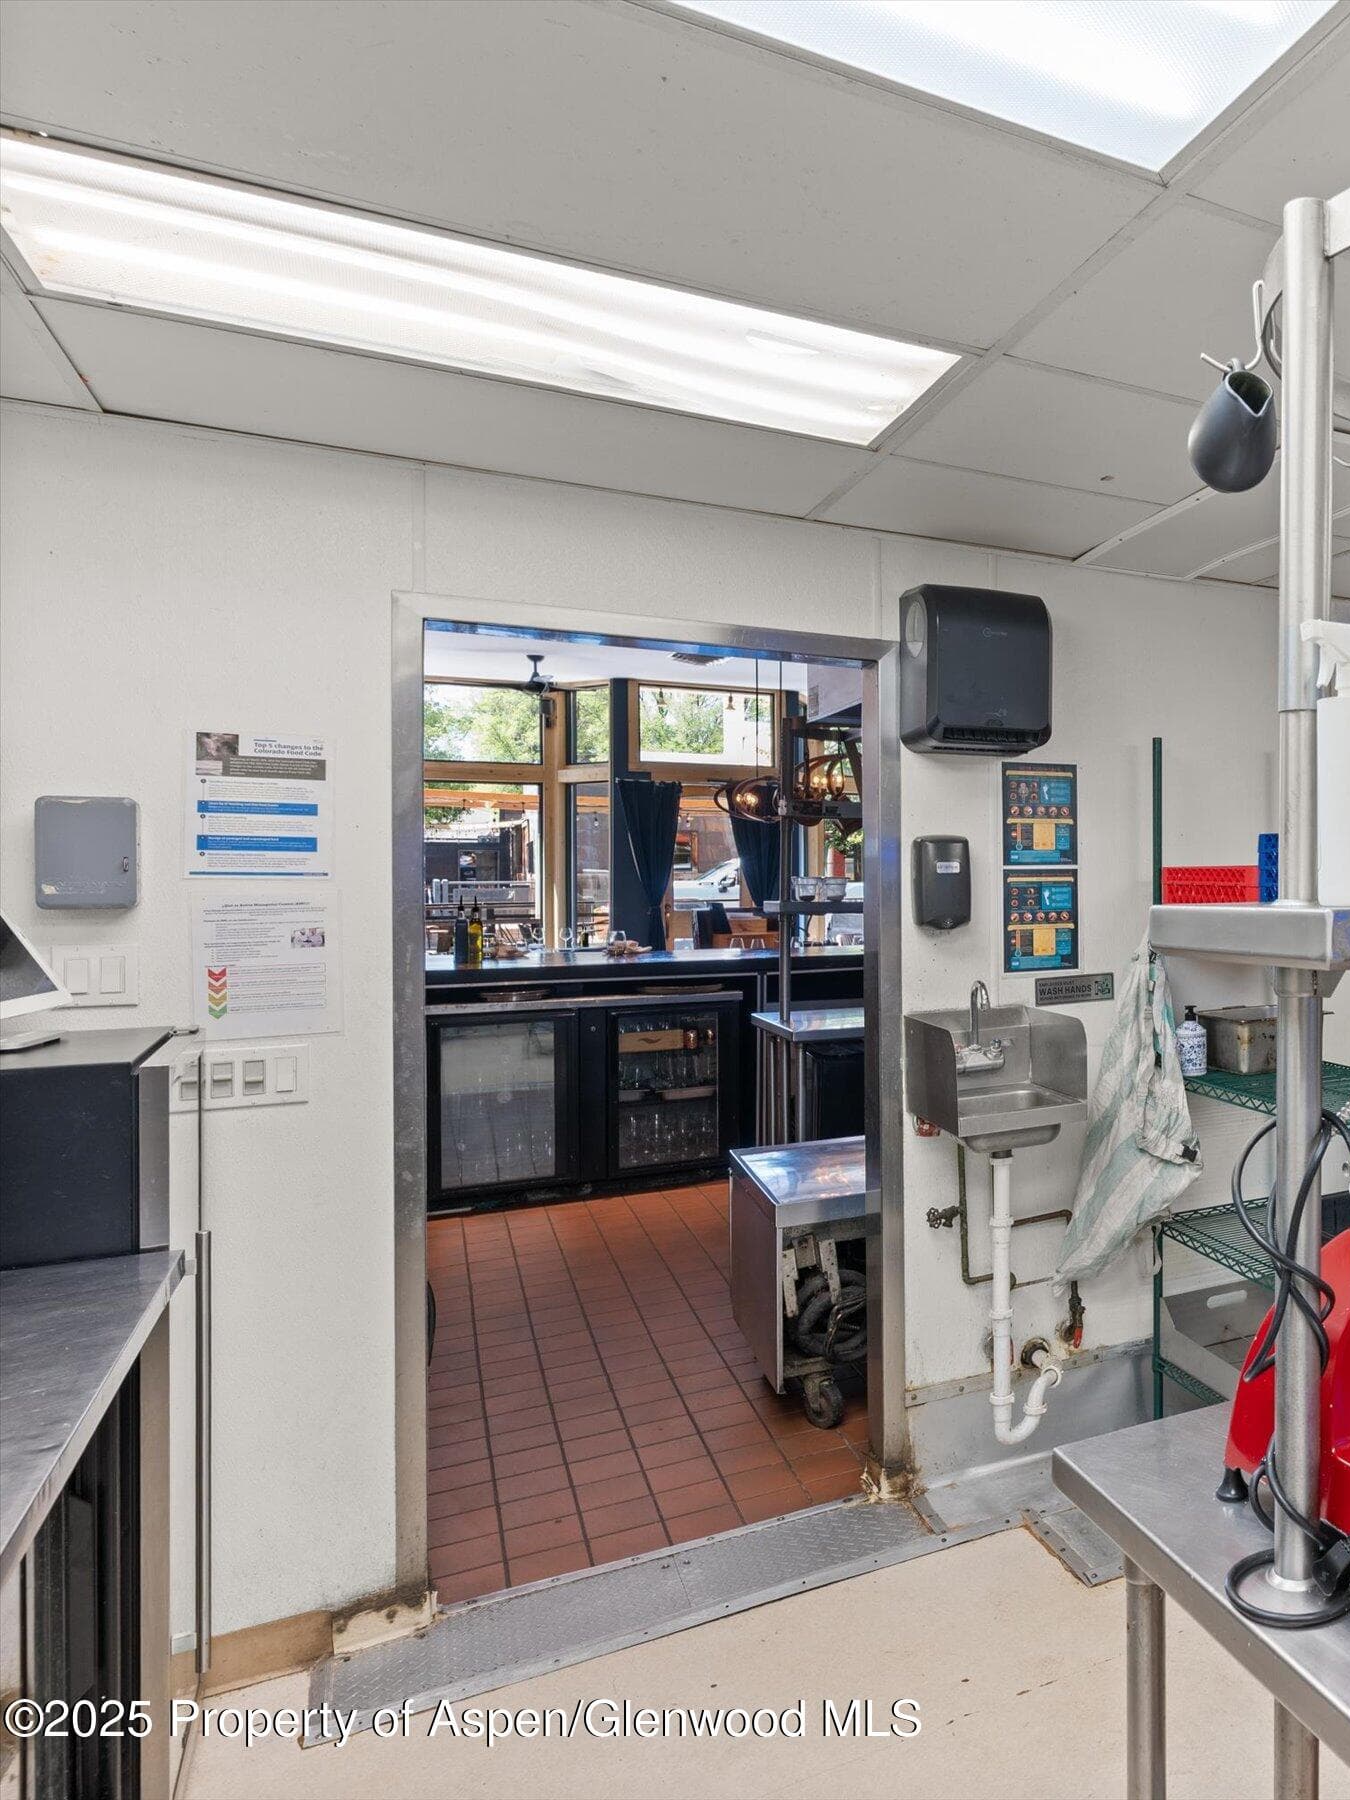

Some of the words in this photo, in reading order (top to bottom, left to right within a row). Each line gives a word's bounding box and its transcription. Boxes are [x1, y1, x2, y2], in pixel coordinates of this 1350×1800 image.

[274, 743, 302, 751] changes
[1039, 986, 1063, 996] WASH
[1064, 984, 1092, 994] HANDS
